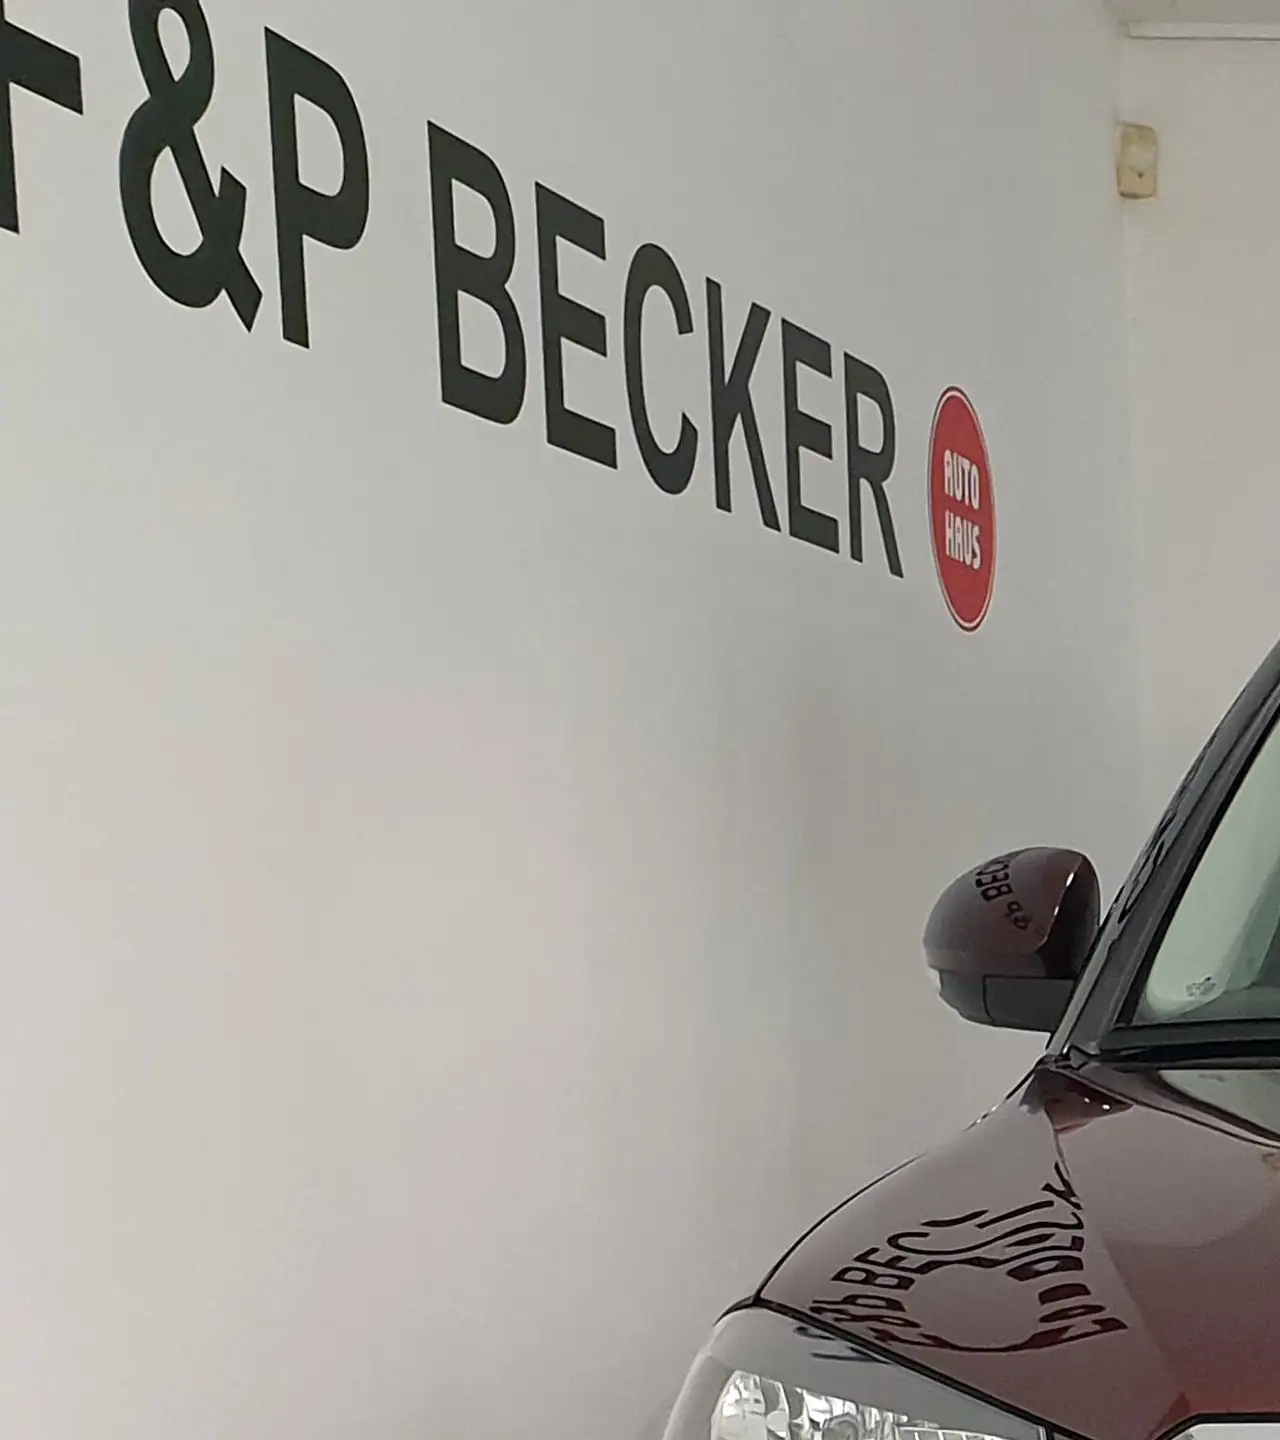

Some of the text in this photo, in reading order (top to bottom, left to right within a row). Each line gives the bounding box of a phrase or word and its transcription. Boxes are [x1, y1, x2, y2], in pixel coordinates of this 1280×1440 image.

[426, 119, 905, 579] BECKER
[943, 448, 980, 510] AUTO
[944, 509, 981, 570] HAUS
